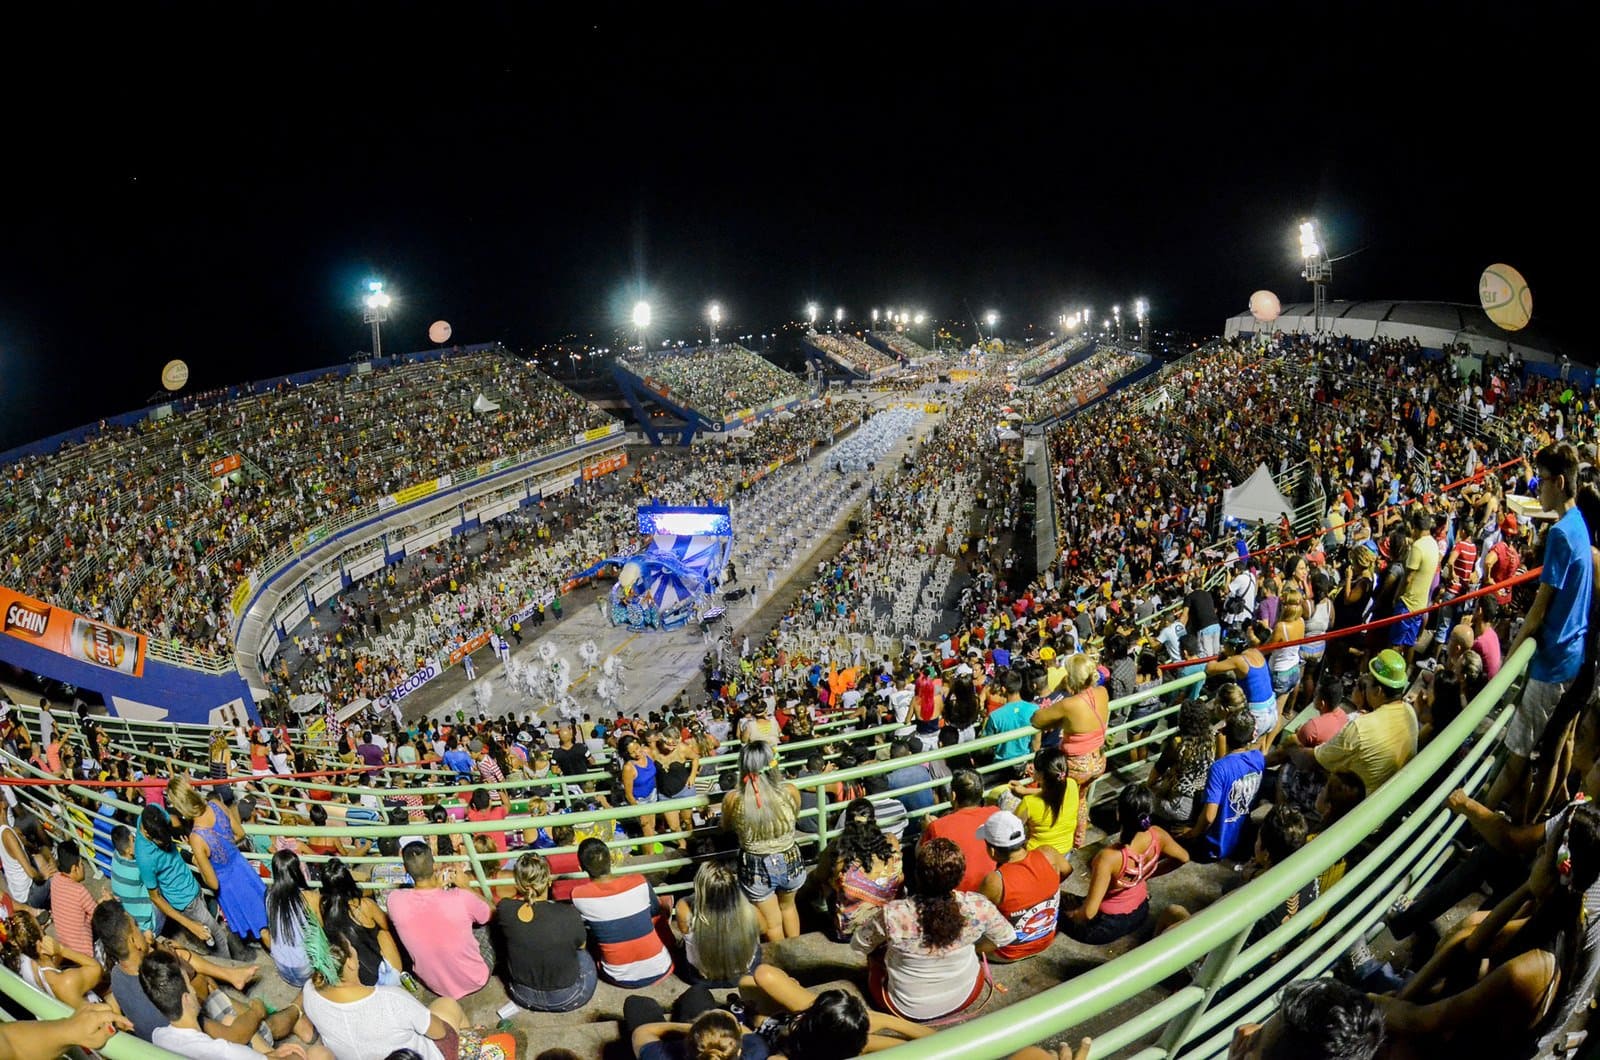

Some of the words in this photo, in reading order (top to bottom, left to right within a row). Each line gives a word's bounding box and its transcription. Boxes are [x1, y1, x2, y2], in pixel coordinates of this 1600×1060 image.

[712, 422, 721, 432] G
[7, 605, 48, 635] SCHIN
[95, 625, 112, 666] SCHIN
[389, 666, 435, 701] RECORD
